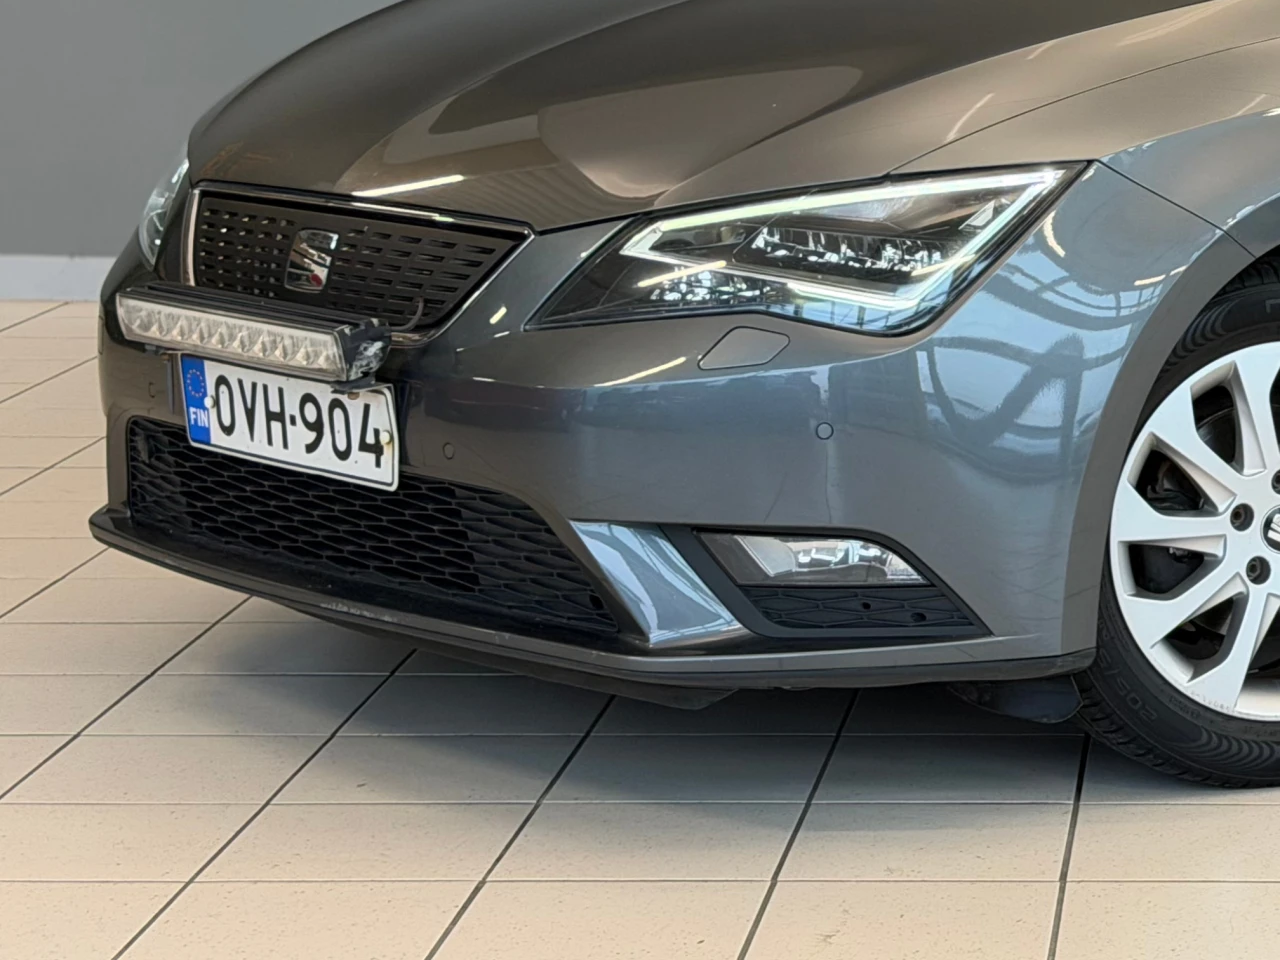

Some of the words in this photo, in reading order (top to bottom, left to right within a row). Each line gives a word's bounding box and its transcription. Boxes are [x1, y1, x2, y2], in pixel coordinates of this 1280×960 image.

[190, 406, 209, 428] FIN
[215, 375, 385, 468] OVH-904
[1097, 640, 1158, 722] 205/5
